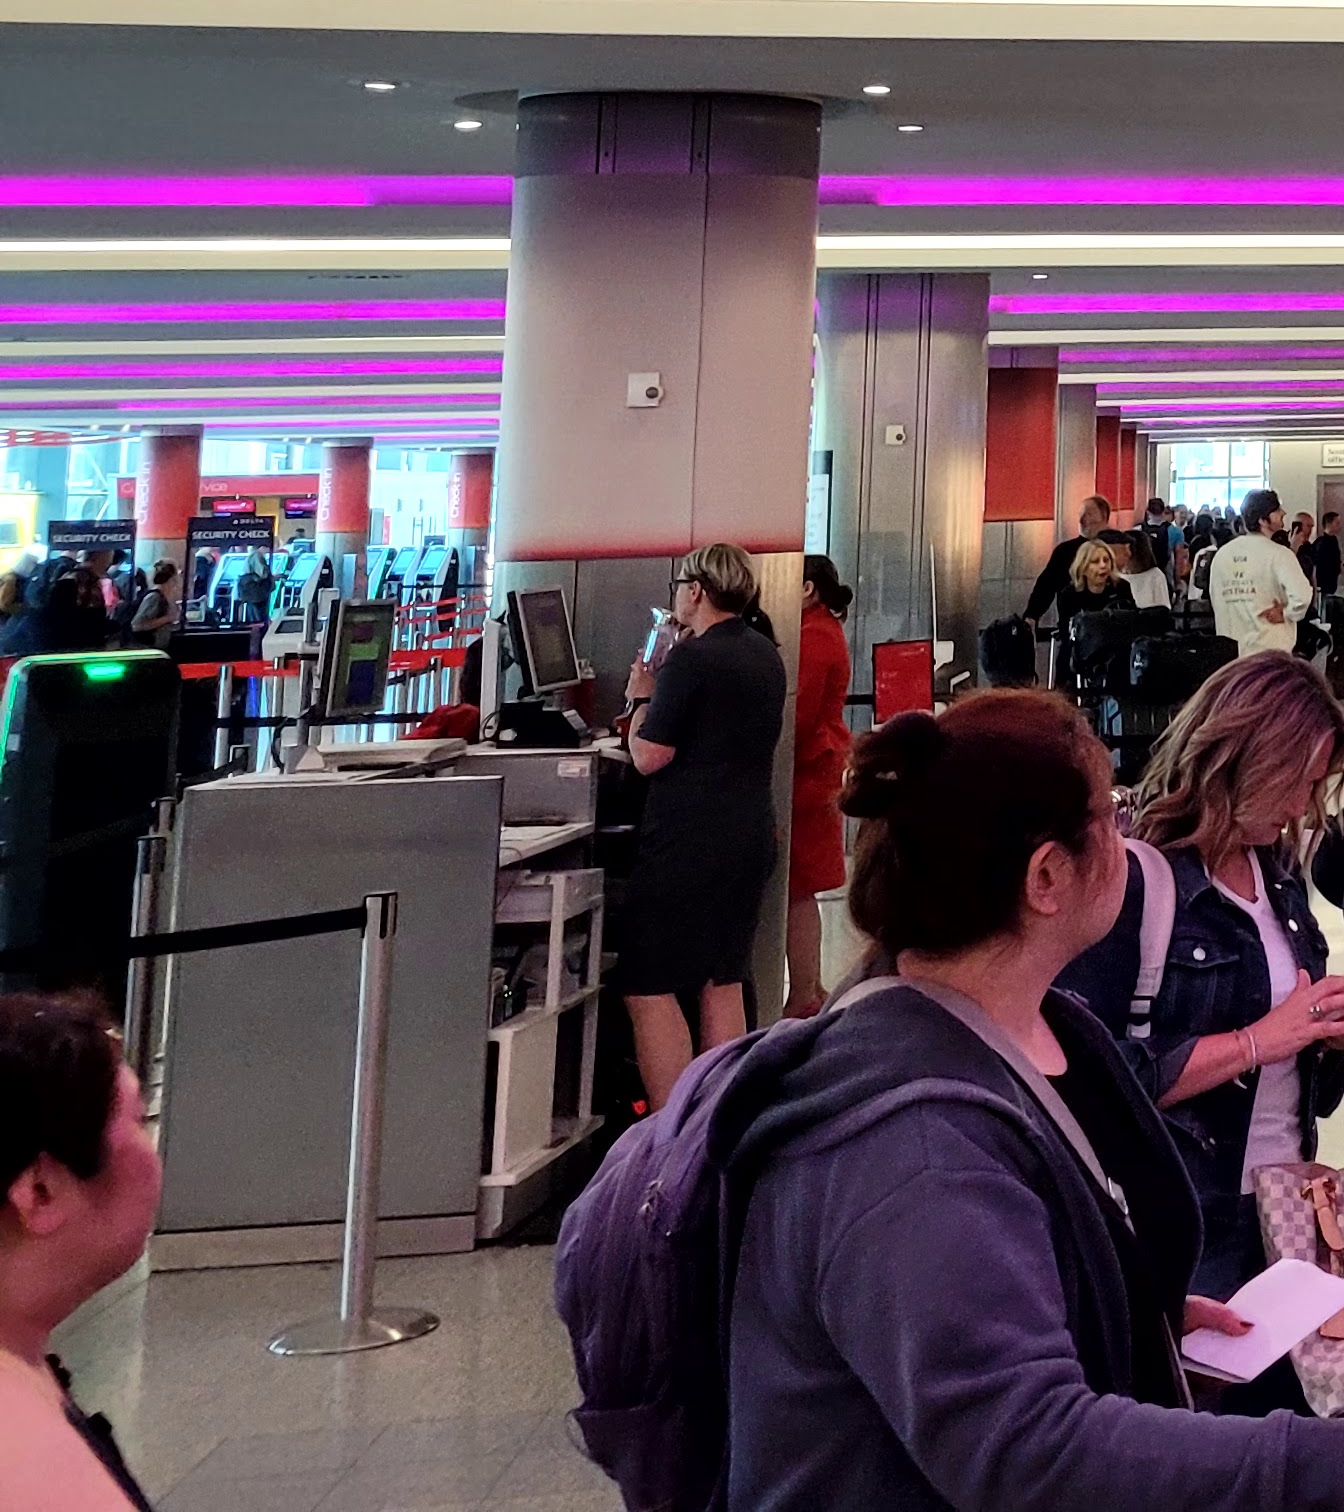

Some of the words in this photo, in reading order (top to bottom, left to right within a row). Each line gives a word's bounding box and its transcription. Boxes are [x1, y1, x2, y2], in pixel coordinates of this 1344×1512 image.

[320, 482, 332, 521] Check
[450, 484, 461, 518] Check
[99, 533, 131, 542] CHECK
[192, 530, 238, 540] SECURITY
[238, 530, 270, 539] CHECK
